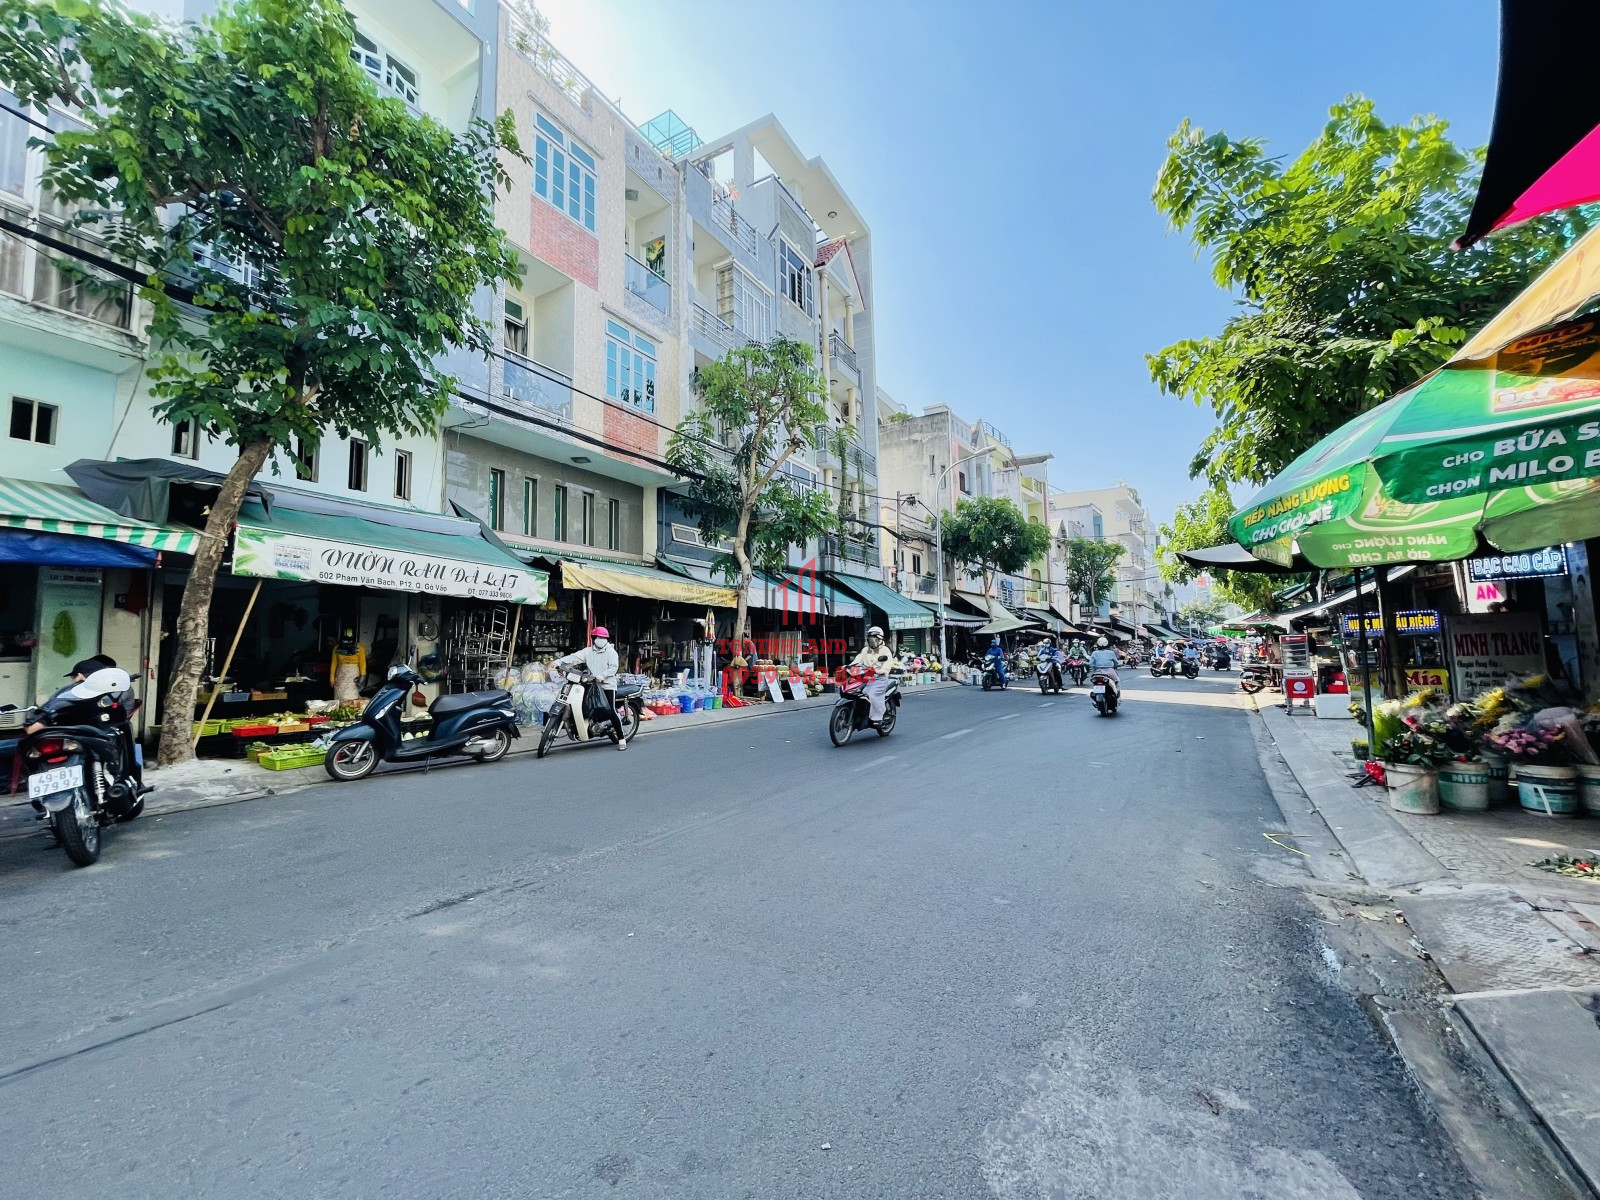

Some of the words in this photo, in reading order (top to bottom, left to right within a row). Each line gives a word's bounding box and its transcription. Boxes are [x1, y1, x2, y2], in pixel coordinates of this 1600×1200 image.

[1442, 450, 1485, 468] CHO
[1493, 428, 1567, 457] BỮA
[1425, 475, 1481, 497] CHỌN
[1489, 455, 1574, 483] MILO
[1243, 505, 1266, 528] TIẾP
[1267, 493, 1300, 519] NĂNG
[1302, 474, 1350, 504] LƯỢNG
[1252, 524, 1277, 543] CHO
[321, 548, 395, 574] VƯỜN
[399, 560, 447, 581] RAU
[450, 567, 480, 585] ĐÀ
[483, 572, 519, 591] LẠT
[1473, 558, 1501, 577] BẠC
[1502, 554, 1530, 572] CAO
[1532, 547, 1562, 570] CẤP
[1409, 613, 1436, 628] RIÊNG
[1454, 633, 1489, 657] MINH
[1491, 631, 1540, 656] TRANG
